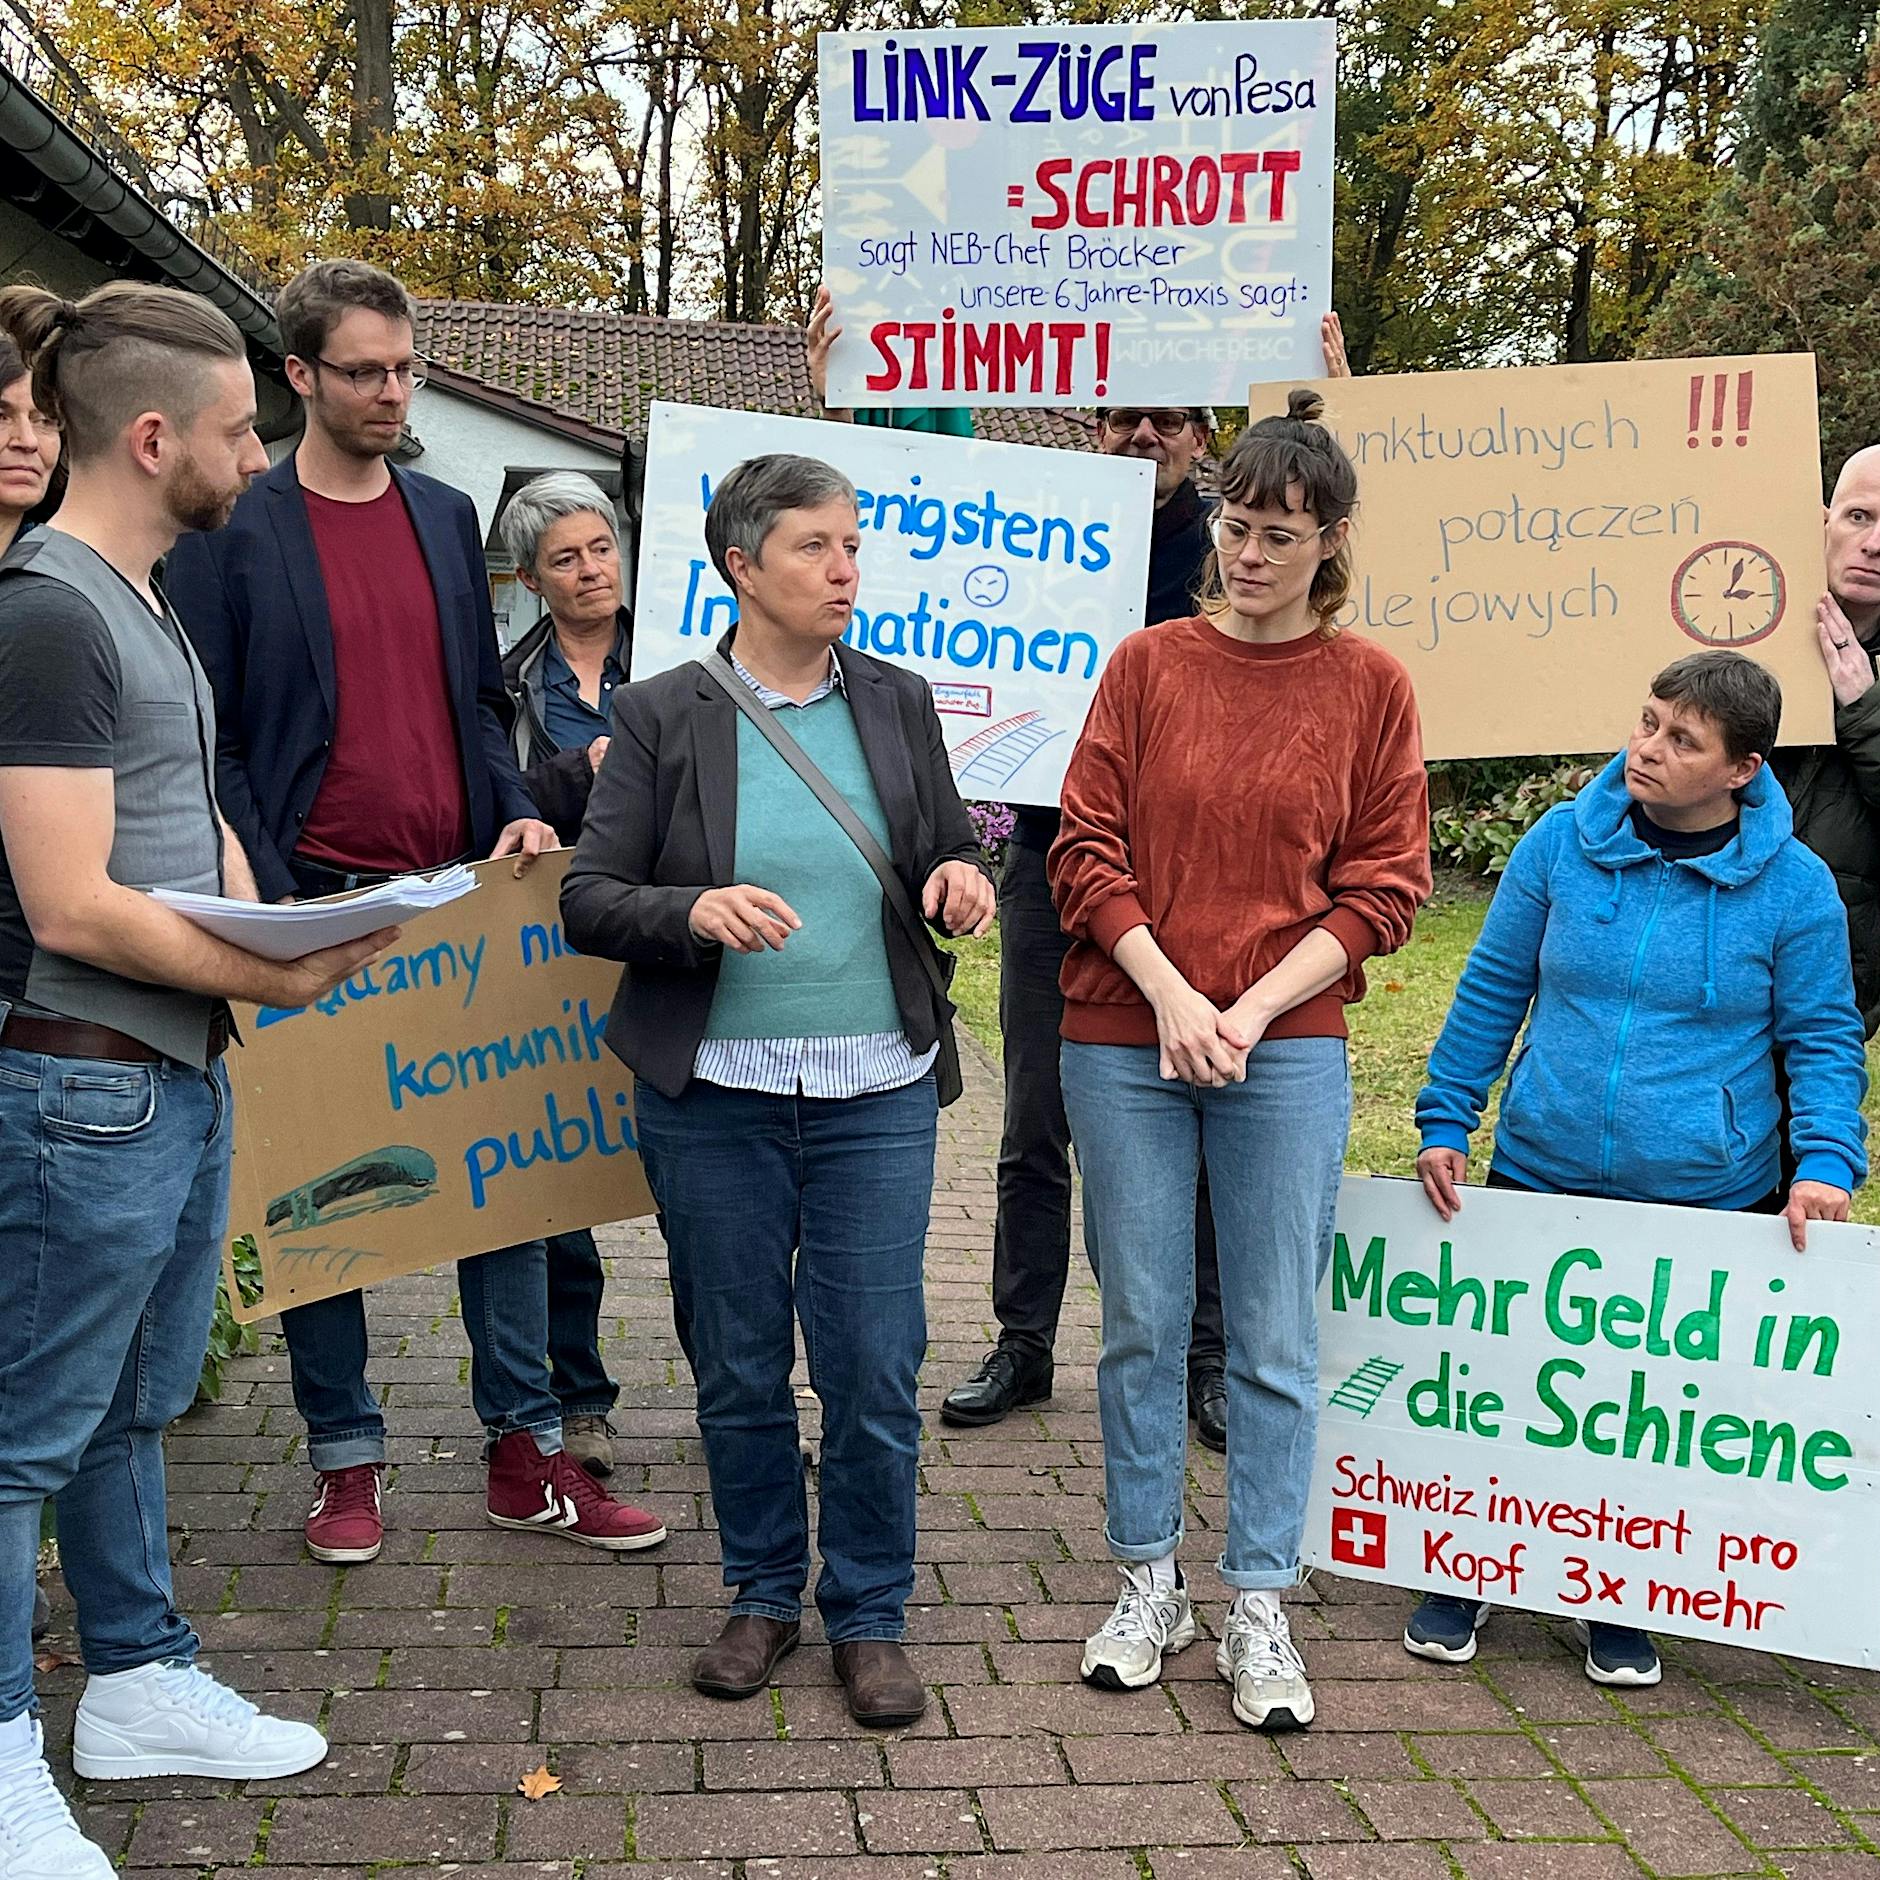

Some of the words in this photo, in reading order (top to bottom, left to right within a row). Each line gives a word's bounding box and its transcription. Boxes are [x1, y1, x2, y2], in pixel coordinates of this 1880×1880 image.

[858, 231, 919, 276] sagt
[931, 232, 1051, 268] NEB-Chef
[1068, 235, 1187, 270] Bröcker
[1239, 277, 1308, 318] sagt:
[1334, 399, 1639, 471] unktualnych
[1438, 492, 1701, 571] połączeń
[1333, 566, 1619, 651] olejowych
[385, 998, 610, 1112] komunik
[464, 1086, 639, 1210] publi
[1331, 1232, 1529, 1337] Mehr
[1544, 1247, 1729, 1363] Geld
[1753, 1278, 1841, 1377] in
[1406, 1351, 1505, 1438] die
[1525, 1357, 1854, 1492] Schiene
[1331, 1454, 1477, 1517] Schweiz
[1487, 1475, 1692, 1555] investiert
[1718, 1531, 1799, 1573] pro
[1423, 1528, 1526, 1595] Kopf
[1647, 1579, 1787, 1632] mehr
